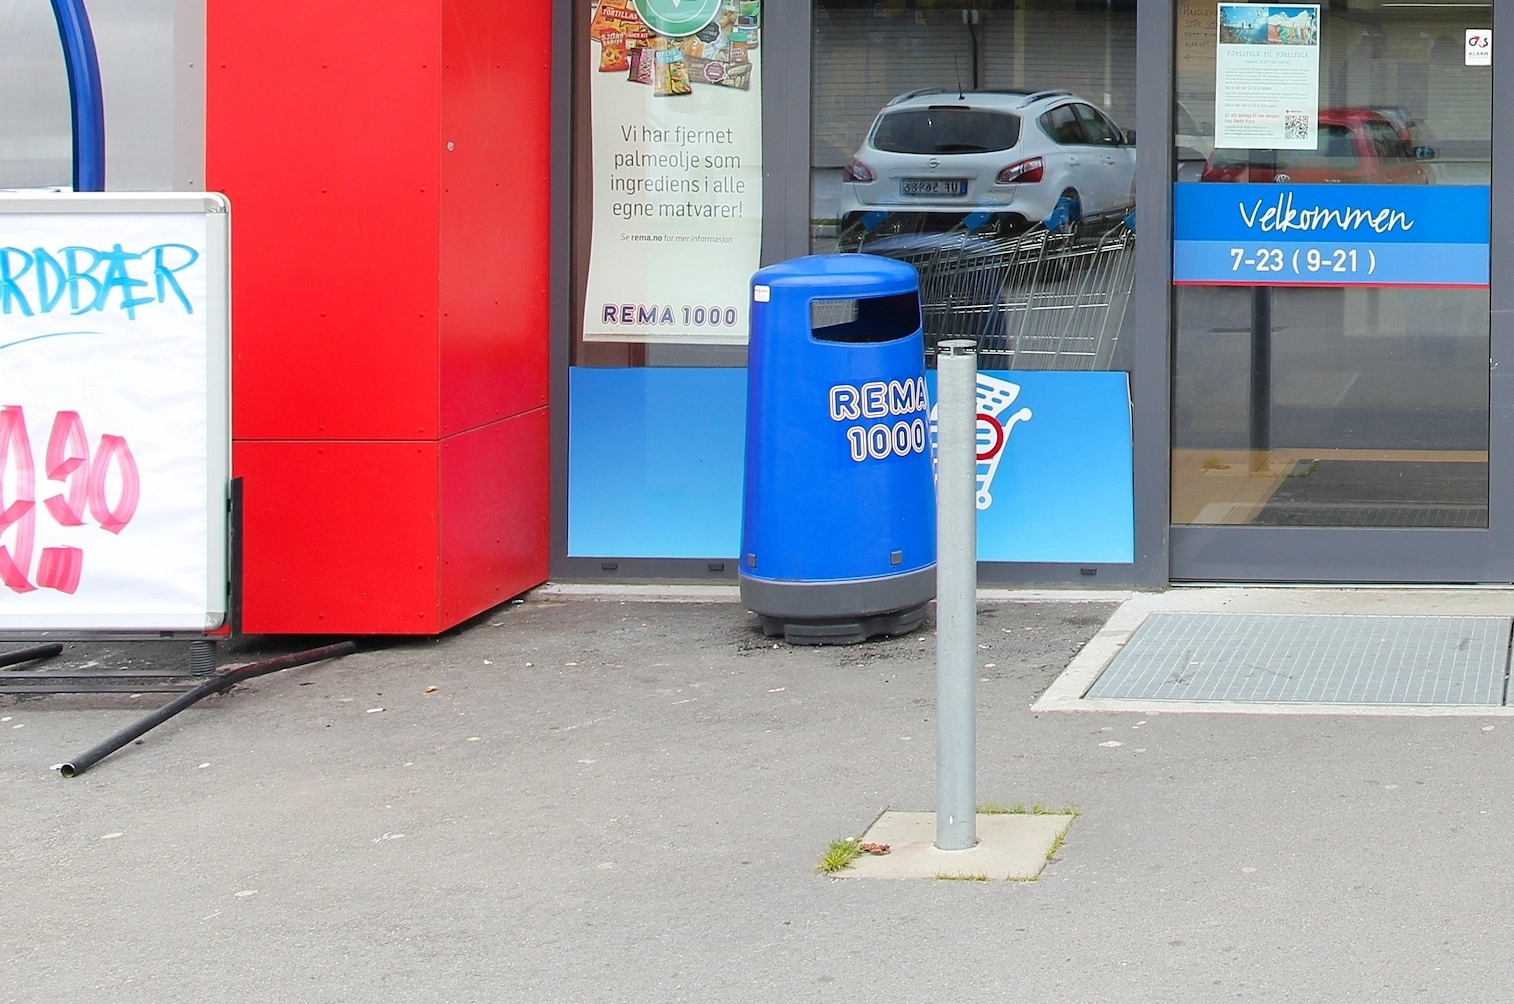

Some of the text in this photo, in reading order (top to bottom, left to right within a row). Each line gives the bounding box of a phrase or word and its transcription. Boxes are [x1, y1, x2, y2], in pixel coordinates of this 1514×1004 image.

[602, 8, 638, 20] TORTILLAS
[621, 125, 733, 147] Vi har fjernet
[614, 150, 741, 171] palmeolje som
[610, 174, 745, 195] ingrediens i alle
[612, 201, 743, 219] egne matvarer!
[1239, 191, 1415, 233] Velkommen
[620, 233, 630, 242] Se
[631, 234, 663, 242] rema.no
[664, 233, 675, 242] for
[690, 234, 733, 244] informasjon
[1230, 248, 1285, 272] 7-23
[602, 303, 738, 327] REMA 1000
[829, 376, 928, 421] REMA
[847, 418, 925, 462] 1000
